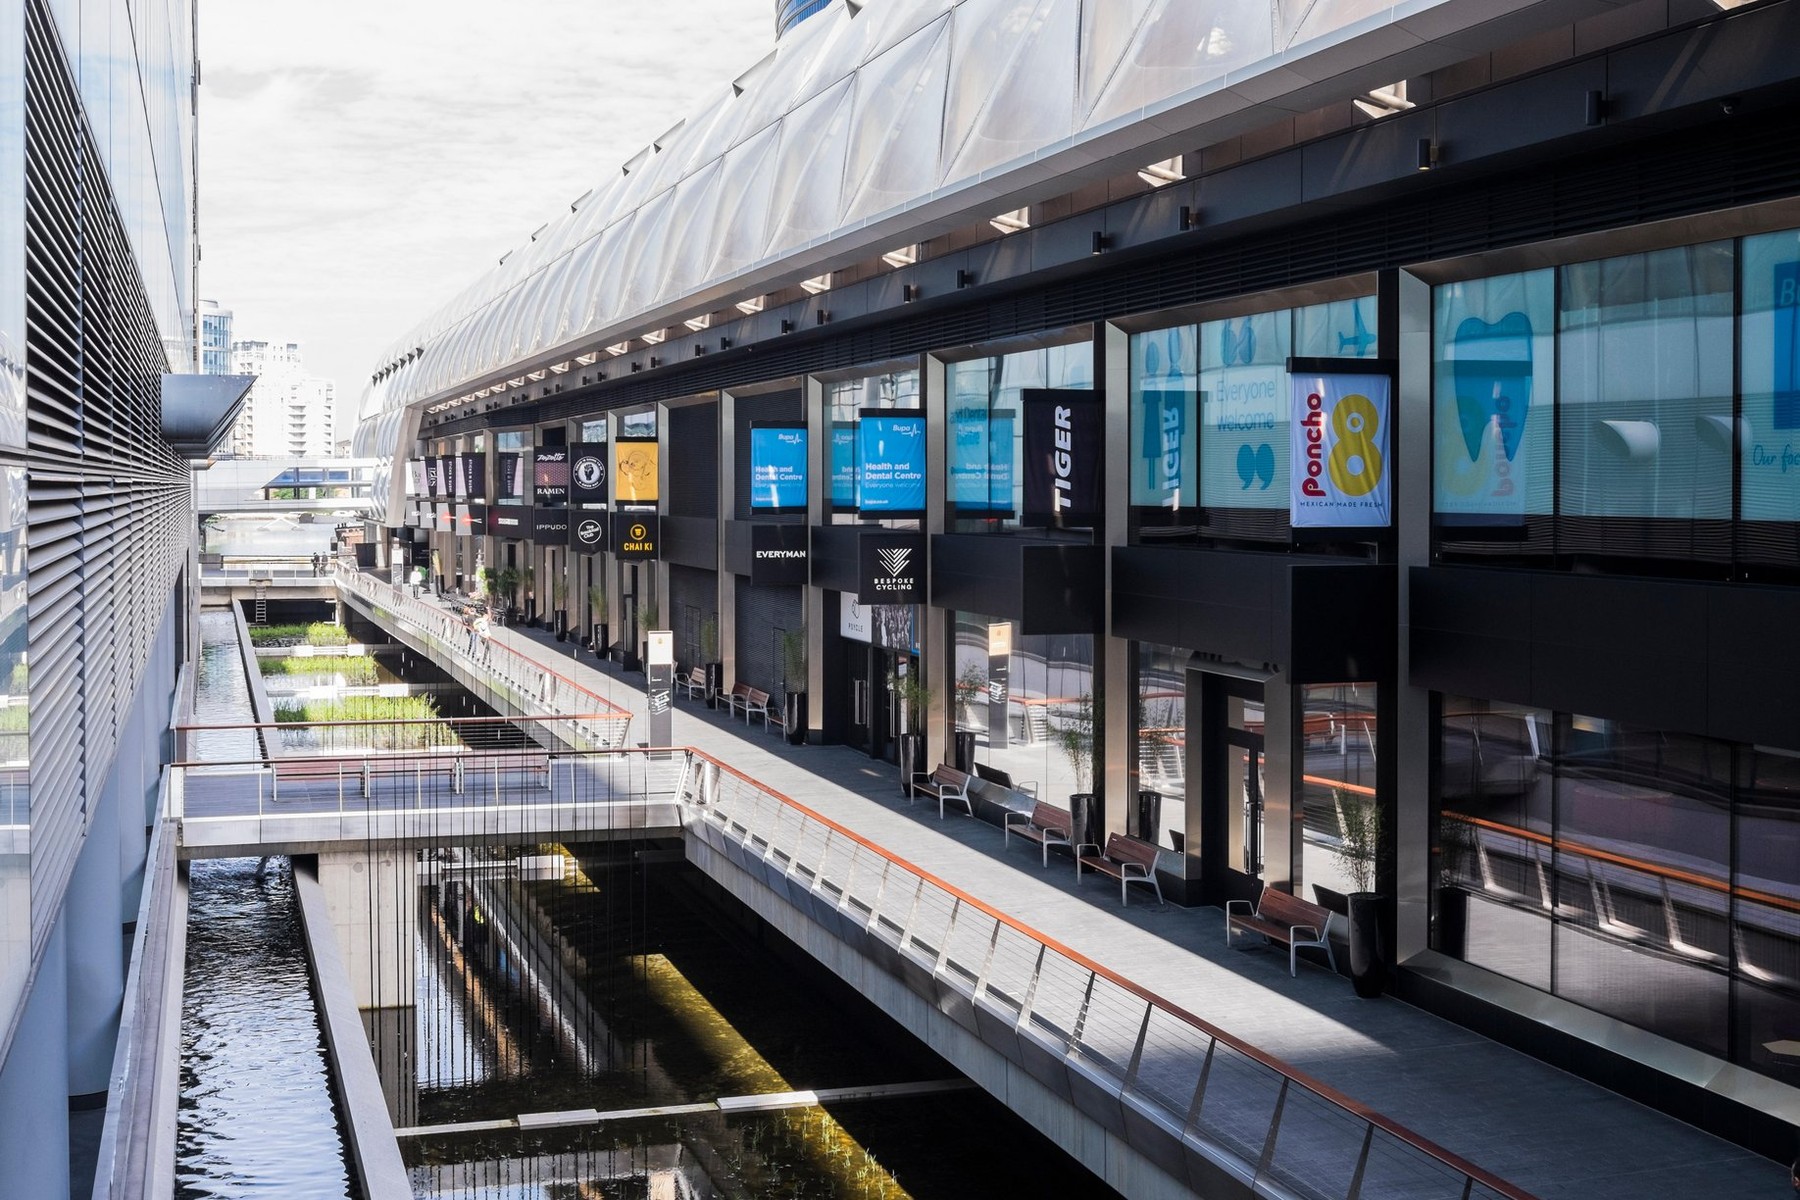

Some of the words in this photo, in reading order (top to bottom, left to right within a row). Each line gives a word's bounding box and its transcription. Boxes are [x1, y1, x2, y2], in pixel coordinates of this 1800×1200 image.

[1217, 379, 1275, 405] Everyone
[1217, 411, 1275, 432] welcome
[892, 424, 911, 433] Bupa
[778, 433, 794, 442] Bupa
[1300, 393, 1327, 497] poncho
[1328, 393, 1383, 497] 8
[1054, 405, 1072, 512] TIGER
[1753, 444, 1777, 466] Our
[755, 465, 778, 473] Heah
[779, 465, 793, 473] and
[865, 462, 893, 471] Health
[894, 462, 910, 471] and
[779, 473, 803, 481] Centre
[865, 472, 893, 480] Dental
[894, 472, 922, 480] Centre
[623, 542, 643, 551] CHAI
[644, 542, 653, 551] KI
[756, 550, 806, 559] EVERYMAN
